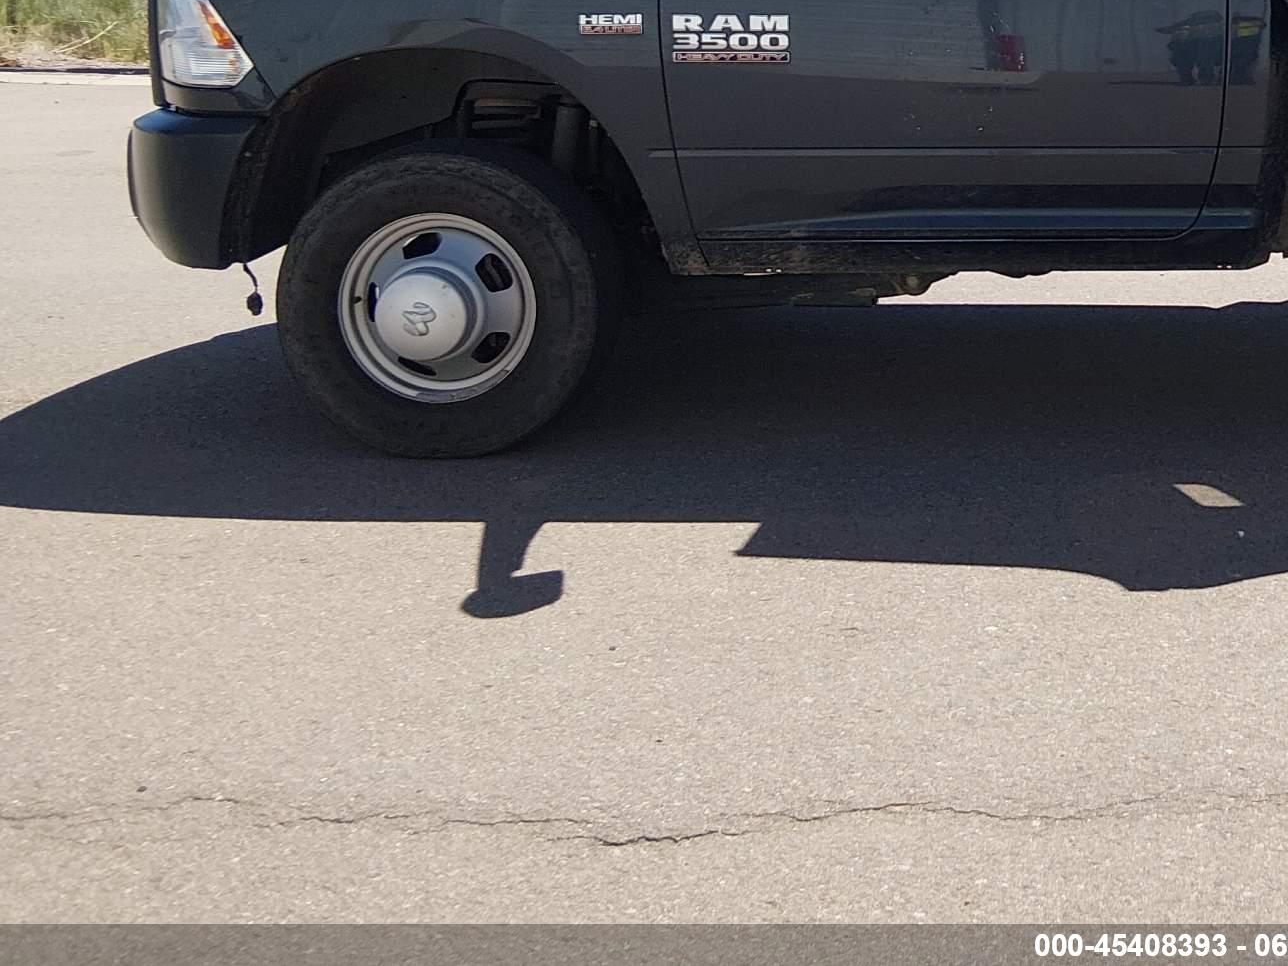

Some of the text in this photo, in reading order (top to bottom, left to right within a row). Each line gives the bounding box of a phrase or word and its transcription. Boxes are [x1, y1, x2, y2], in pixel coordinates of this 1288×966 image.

[579, 14, 642, 24] HEMI
[673, 14, 789, 31] RAM
[673, 34, 789, 50] 3500
[677, 53, 787, 62] HEAVY DUTY
